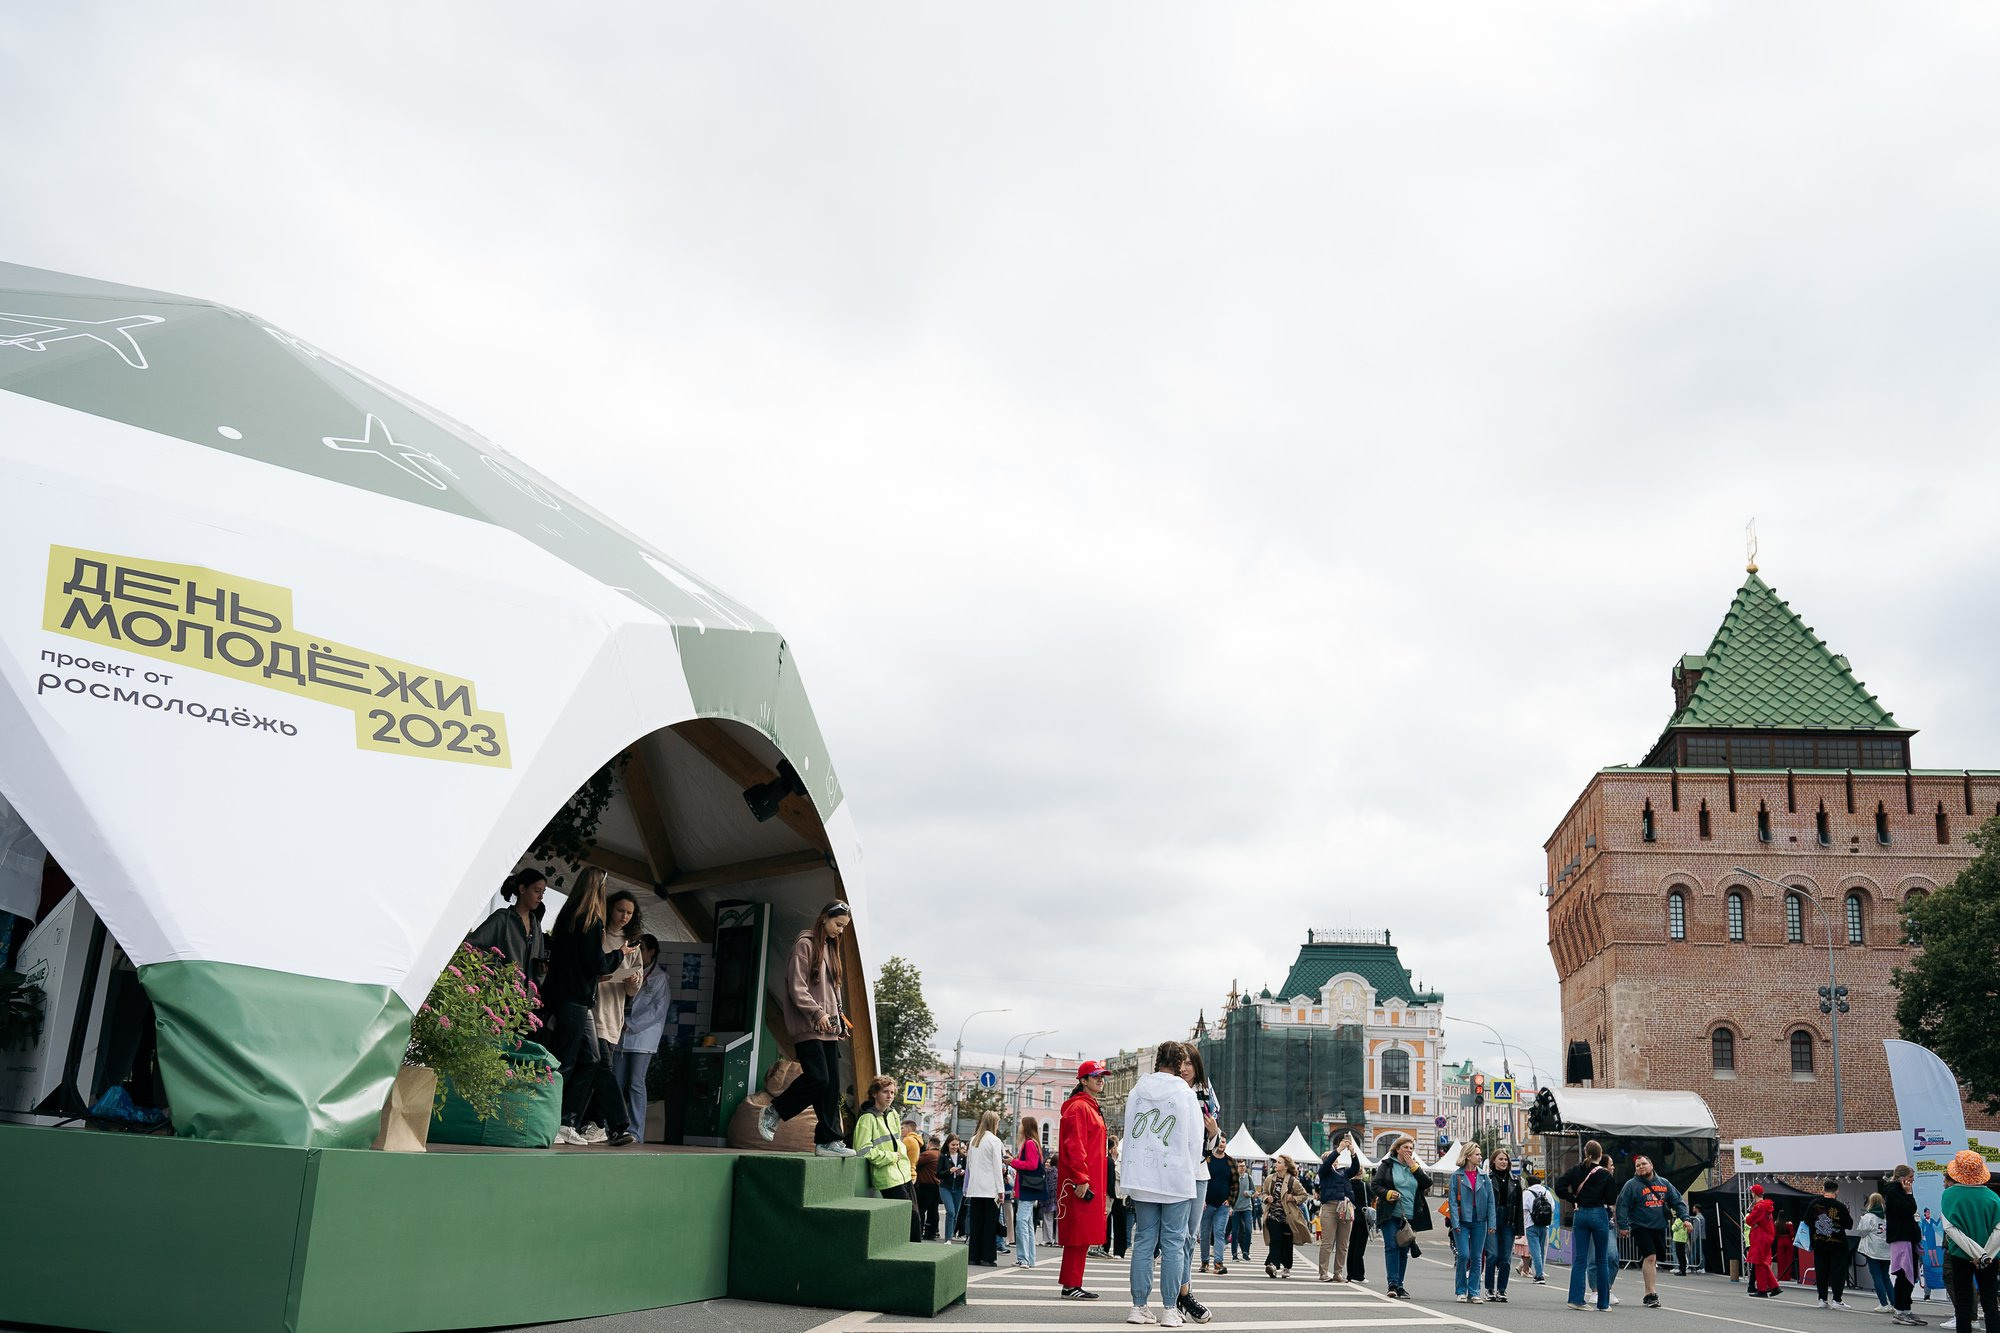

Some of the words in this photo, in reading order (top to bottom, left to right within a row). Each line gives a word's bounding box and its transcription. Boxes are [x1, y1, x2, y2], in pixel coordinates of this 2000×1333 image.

[62, 557, 282, 634] ДЕНЬ
[40, 649, 135, 679] проект
[144, 670, 173, 687] от
[60, 597, 473, 717] МОЛОДЁЖИ
[37, 672, 298, 737] росмолодёжь
[367, 708, 501, 757] 2023
[1913, 1128, 1926, 1151] 5
